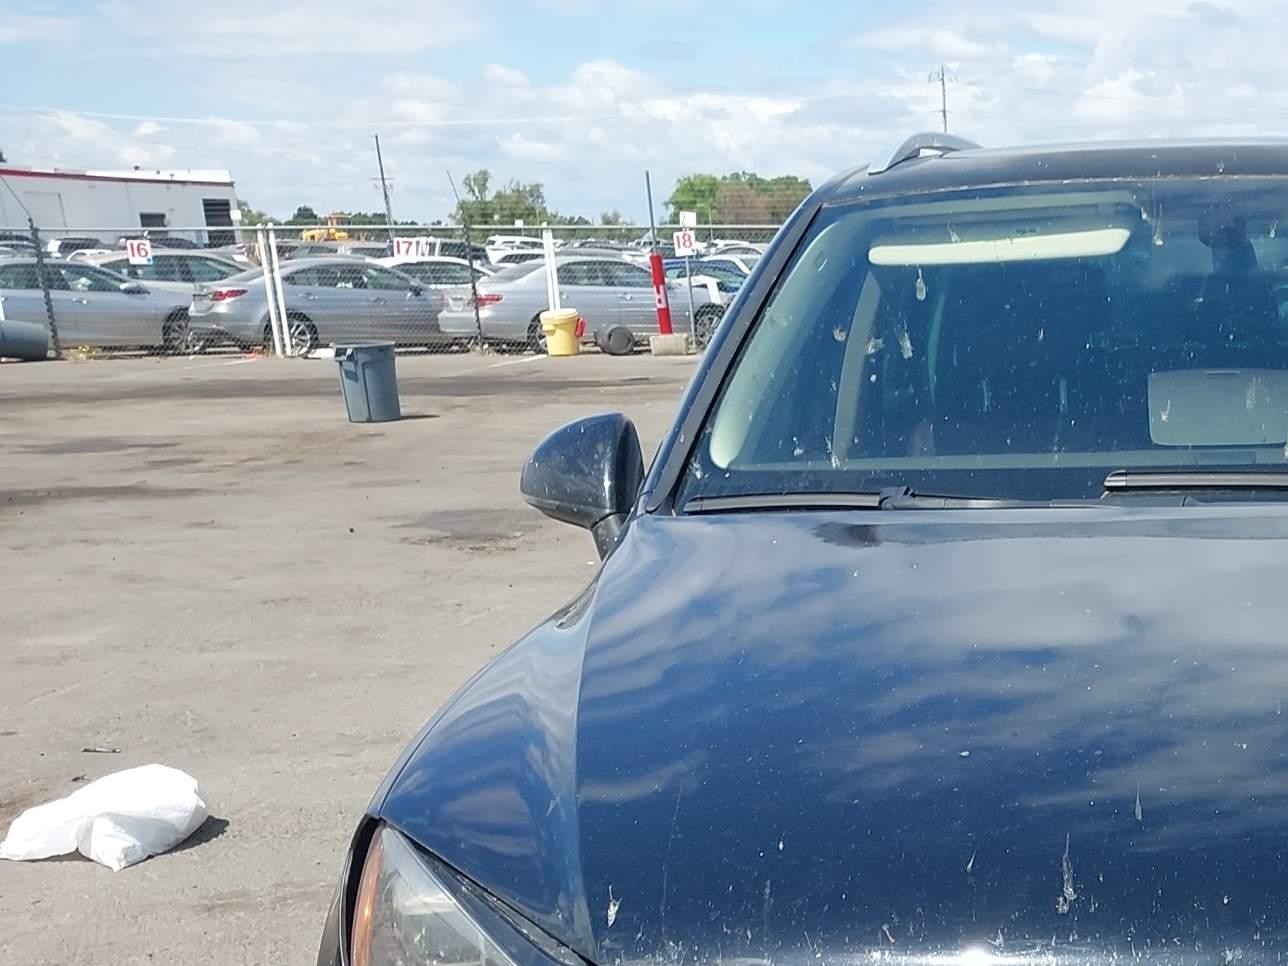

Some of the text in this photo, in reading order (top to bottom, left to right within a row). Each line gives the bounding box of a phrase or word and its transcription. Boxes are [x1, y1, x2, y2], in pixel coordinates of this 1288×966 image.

[396, 239, 413, 256] 17
[676, 232, 693, 249] 18
[129, 242, 149, 258] 16
